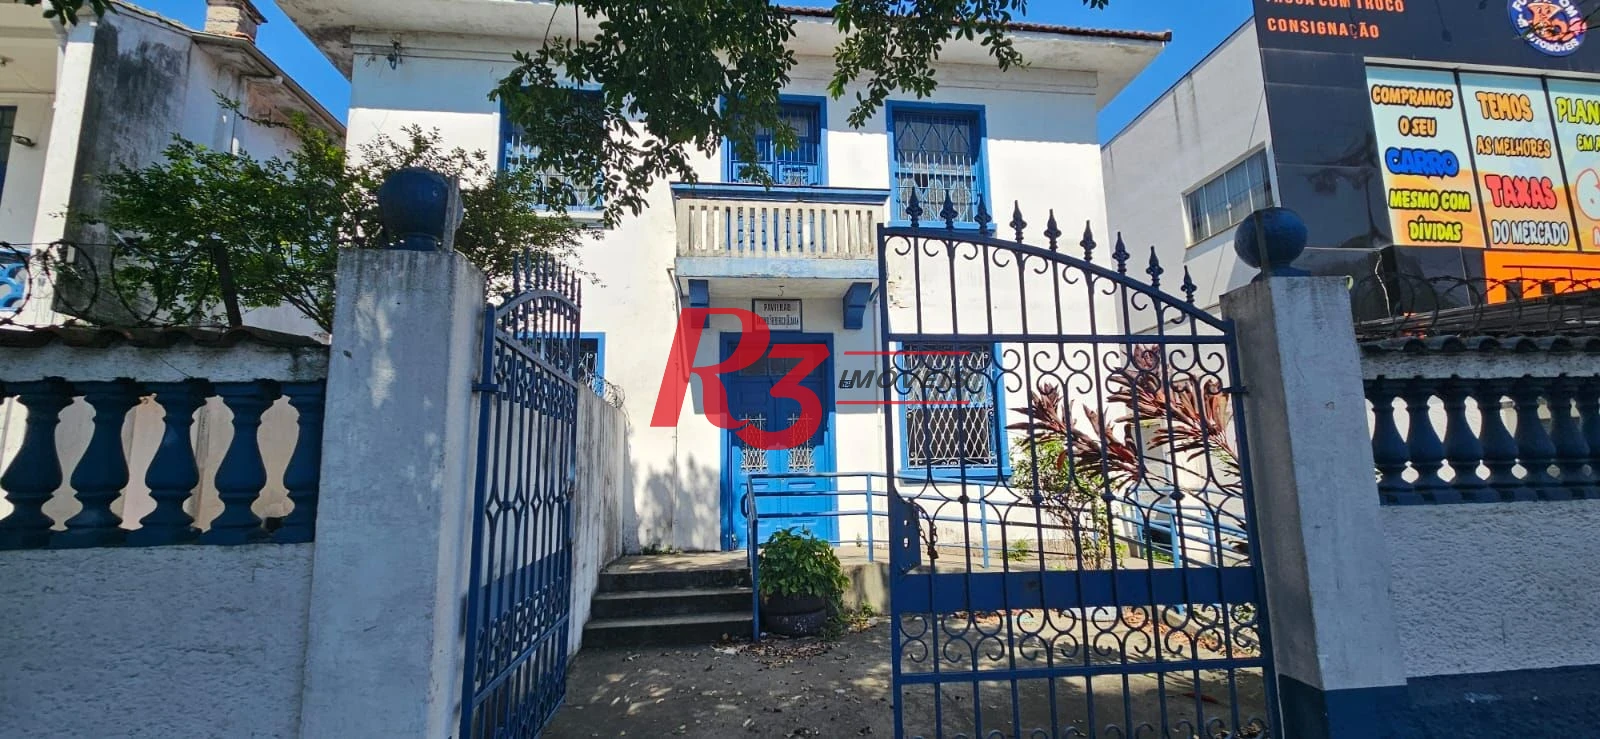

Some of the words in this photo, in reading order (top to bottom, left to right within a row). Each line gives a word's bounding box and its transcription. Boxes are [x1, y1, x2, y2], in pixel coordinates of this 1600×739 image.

[1356, 0, 1405, 12] TROCO
[1267, 17, 1380, 39] CONSIGNAÇÃO
[1525, 33, 1580, 52] UTOMÓVEIS
[1371, 84, 1453, 108] COMPRAMOS
[1475, 91, 1534, 122] TEMOS
[1399, 115, 1410, 136] O
[1411, 116, 1437, 137] SEU
[1476, 135, 1493, 156] AS
[1493, 136, 1552, 159] MELHORES
[1576, 133, 1594, 152] EM
[1385, 146, 1459, 179] CARRO
[1389, 188, 1439, 211] MESMO
[1440, 190, 1472, 212] COM
[1485, 174, 1557, 210] TAXAS
[1408, 215, 1462, 242] DÍVIDAS
[1492, 219, 1509, 245] DO
[1511, 220, 1569, 246] MERCADO
